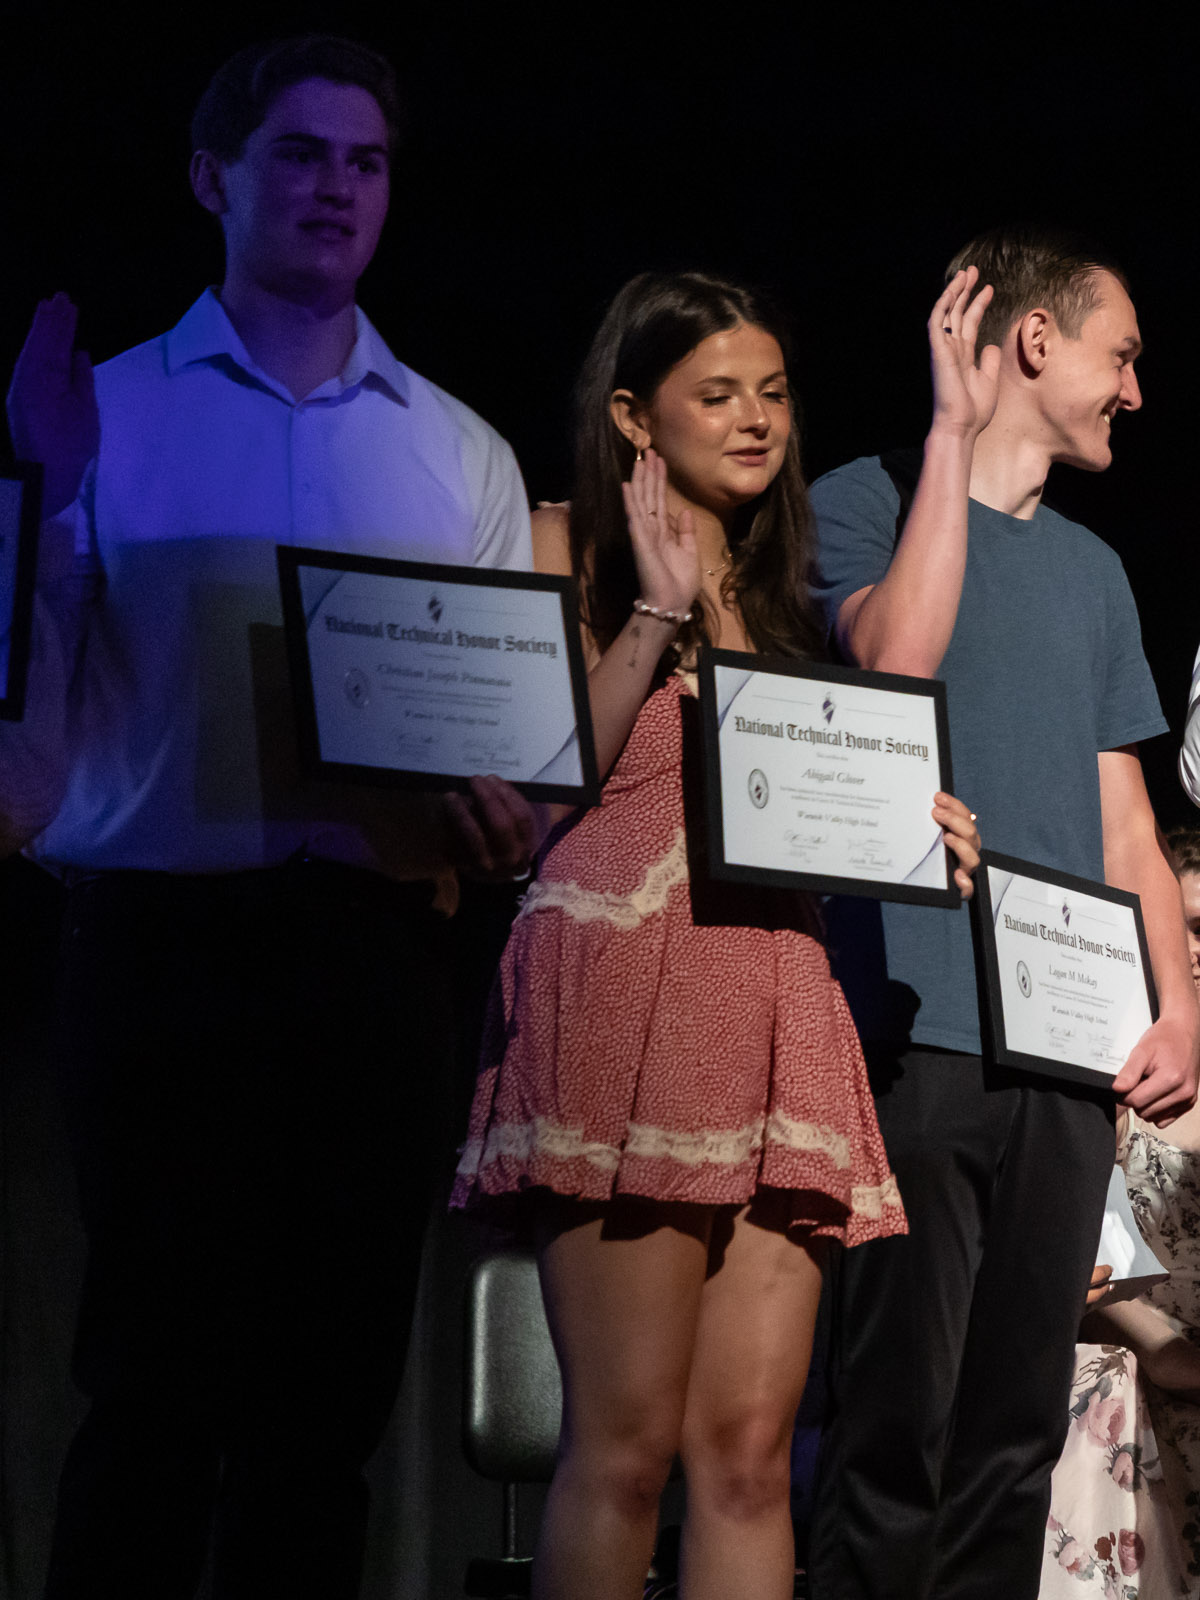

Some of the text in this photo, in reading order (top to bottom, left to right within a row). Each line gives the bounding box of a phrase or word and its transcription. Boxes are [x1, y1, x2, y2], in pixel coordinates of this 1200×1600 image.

[325, 616, 557, 659] National Technical Honor Society
[734, 716, 929, 762] National Technical Honor Society
[801, 768, 835, 783] Abigail
[1004, 913, 1038, 937] National
[1040, 924, 1077, 949] Technical
[1079, 935, 1104, 957] Honor
[1106, 942, 1137, 968] Society
[1049, 964, 1067, 981] Logan
[1069, 970, 1076, 982] M
